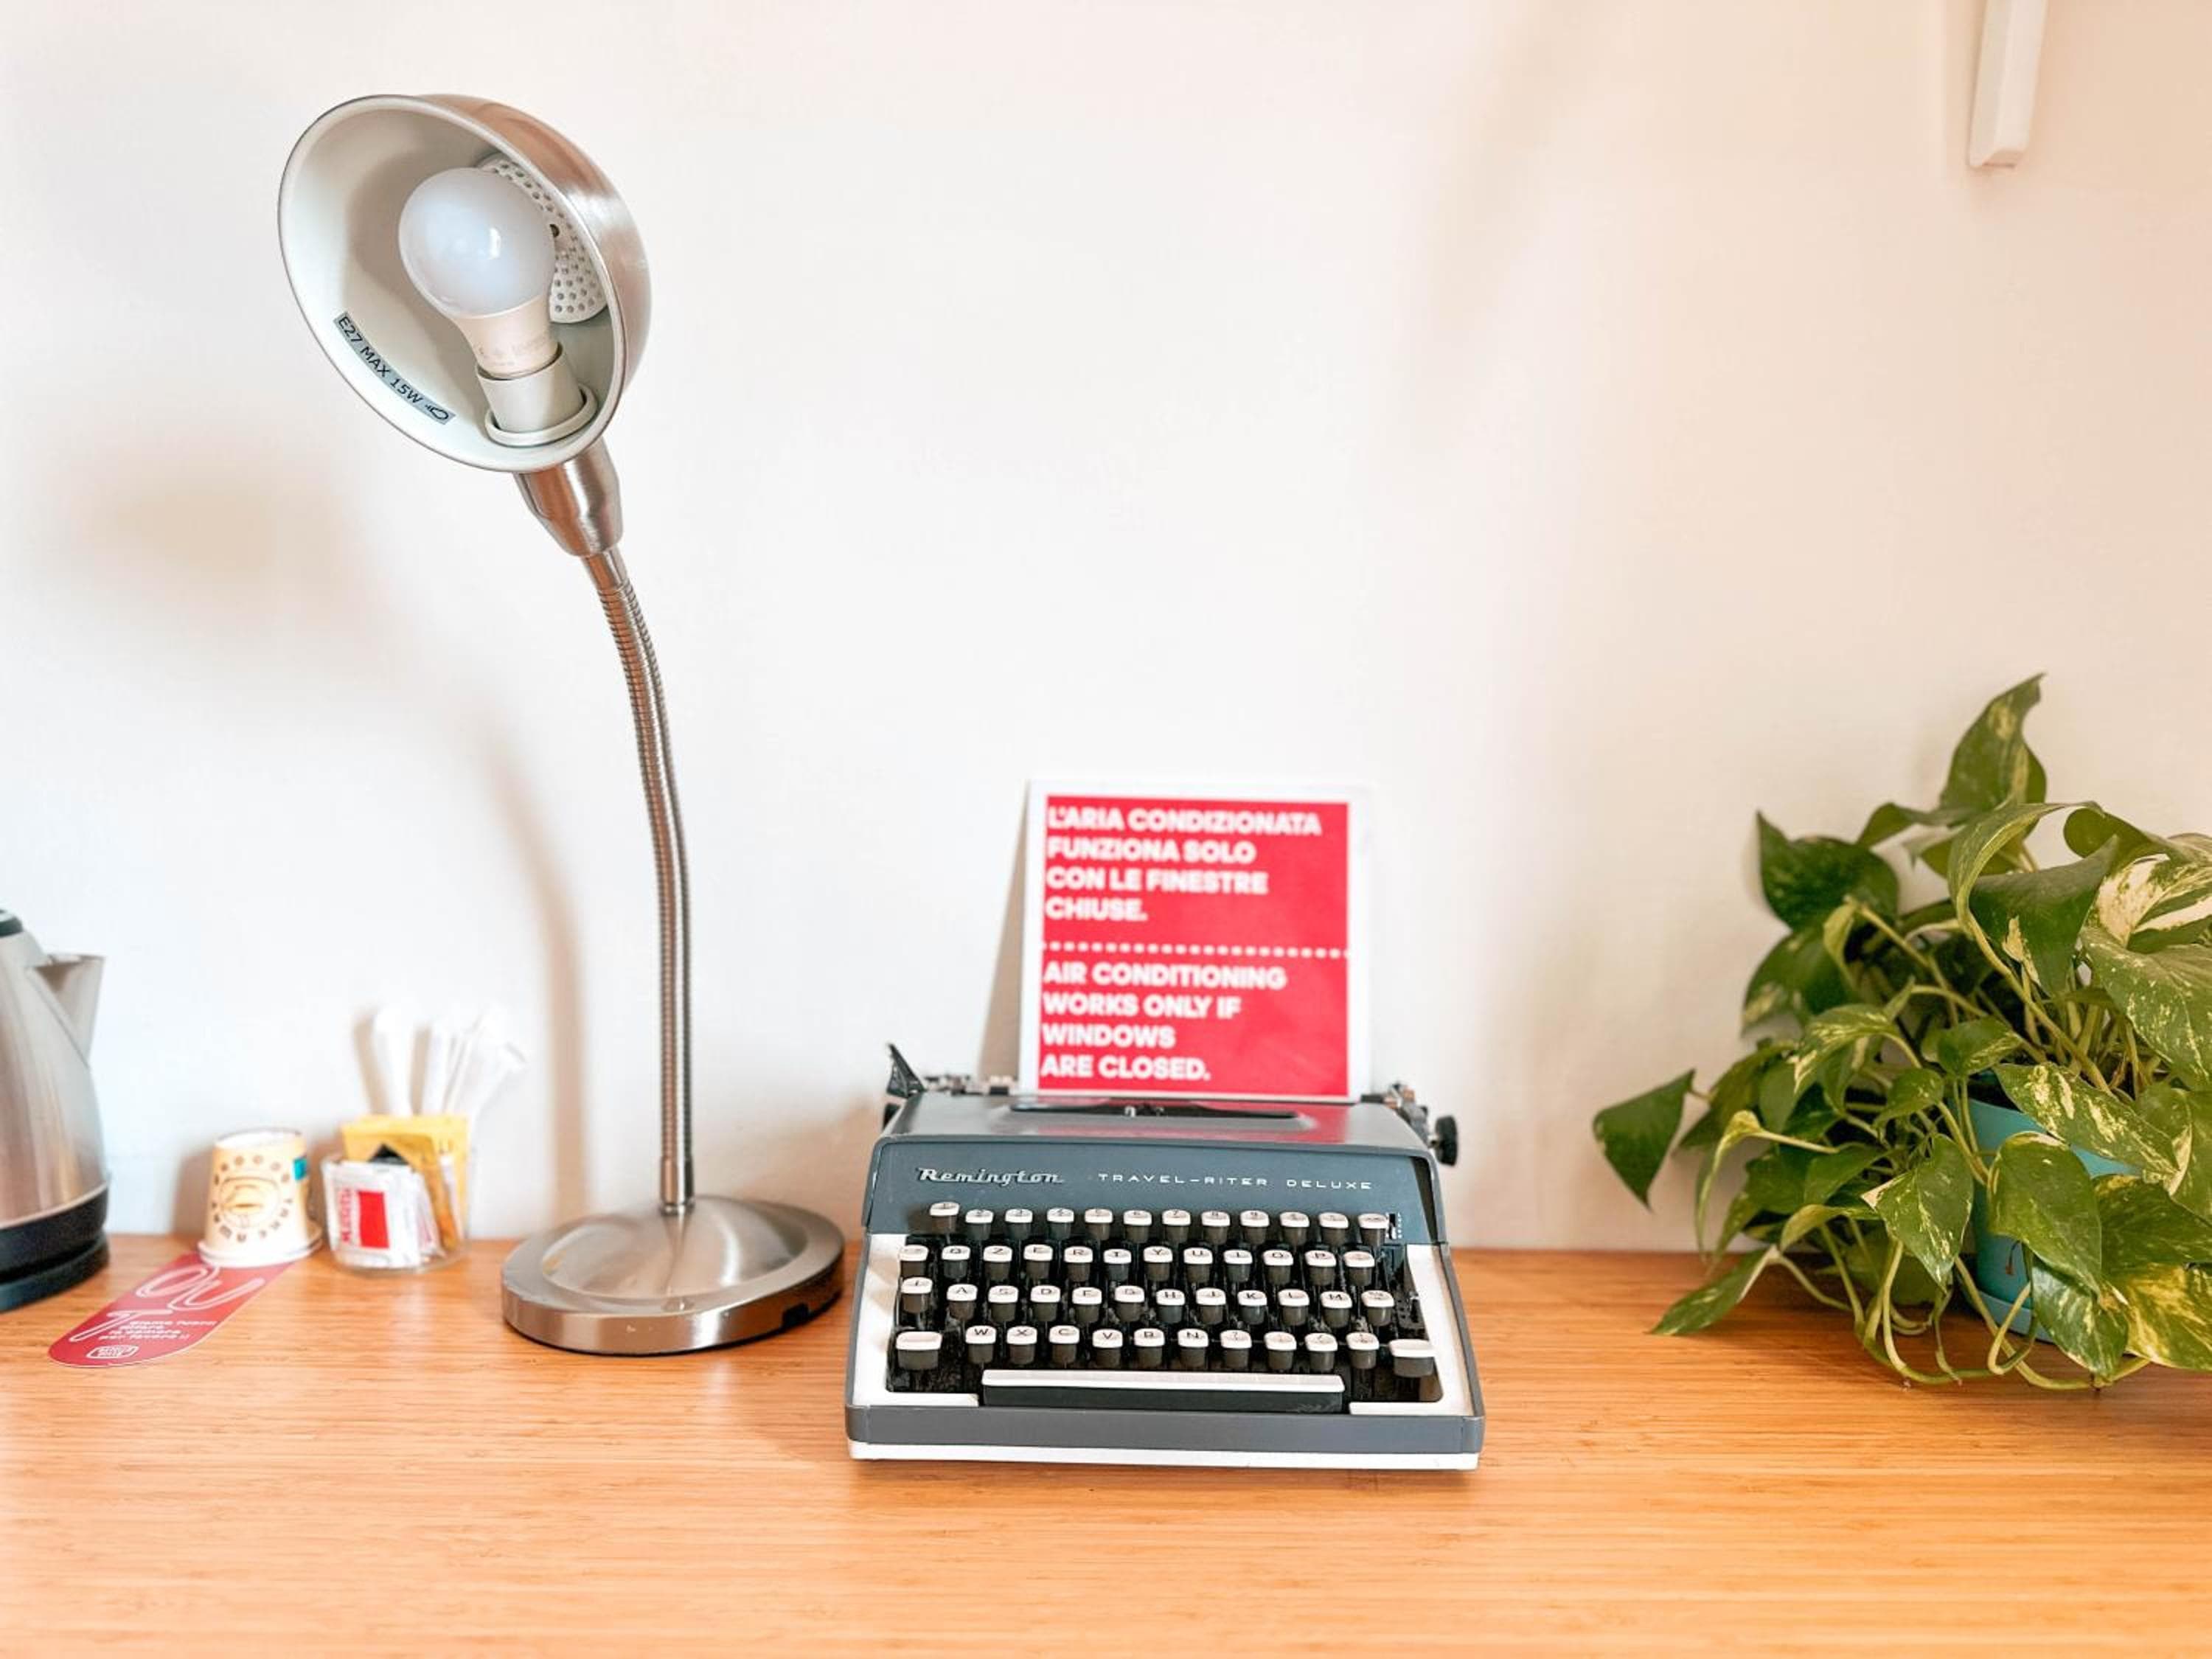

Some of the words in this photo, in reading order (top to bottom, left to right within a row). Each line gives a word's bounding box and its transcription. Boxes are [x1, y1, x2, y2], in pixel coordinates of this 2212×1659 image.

[338, 316, 363, 342] E27
[360, 346, 390, 378] MAX
[390, 378, 423, 403] 15W
[1047, 807, 1124, 830] L'ARIA
[1127, 808, 1322, 835] CONDIZIONATA
[1046, 837, 1180, 862] FUNZIONA
[1183, 840, 1256, 864] SOLO
[1045, 867, 1106, 890] CON
[1109, 869, 1142, 891] LE
[1146, 869, 1268, 895] FINESTRE
[1045, 896, 1148, 922] CHIUSE.
[1043, 961, 1088, 984] AIR
[1091, 962, 1288, 990] CONDITIONING
[1042, 992, 1139, 1017] WORKS
[1143, 994, 1212, 1018] ONLY
[1217, 996, 1242, 1019] IF
[1042, 1023, 1176, 1048] WINDOWS
[1040, 1054, 1093, 1077] ARE
[1098, 1055, 1211, 1081] CLOSED.
[917, 1167, 1064, 1186] Remington
[1287, 1179, 1372, 1190] DELUXE
